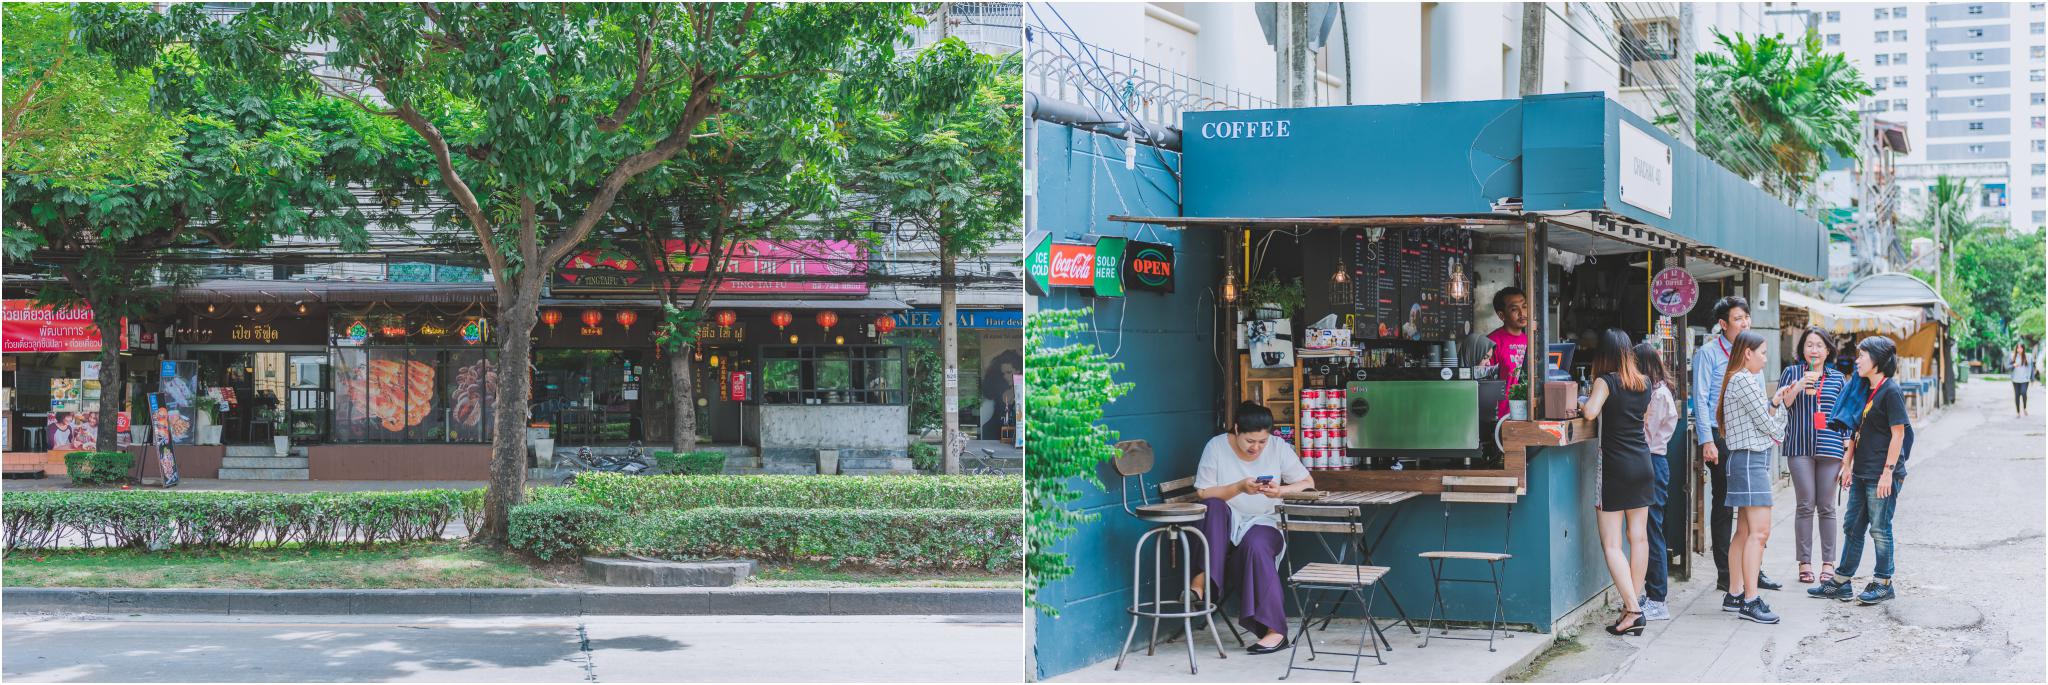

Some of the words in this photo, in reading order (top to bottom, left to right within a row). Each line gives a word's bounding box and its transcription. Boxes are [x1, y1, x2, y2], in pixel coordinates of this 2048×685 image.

[1201, 119, 1291, 139] COFFEE
[1035, 252, 1048, 263] ICE
[1096, 256, 1116, 267] SOLD
[1031, 264, 1049, 276] COLD
[1051, 251, 1093, 279] Coca-Cola
[1132, 258, 1171, 277] OPEN
[1095, 268, 1116, 279] HERE
[731, 280, 754, 288] TING
[758, 280, 773, 288] TAI
[776, 280, 788, 288] FU
[985, 317, 1004, 326] Hair
[39, 324, 84, 337] พัฒนาการ
